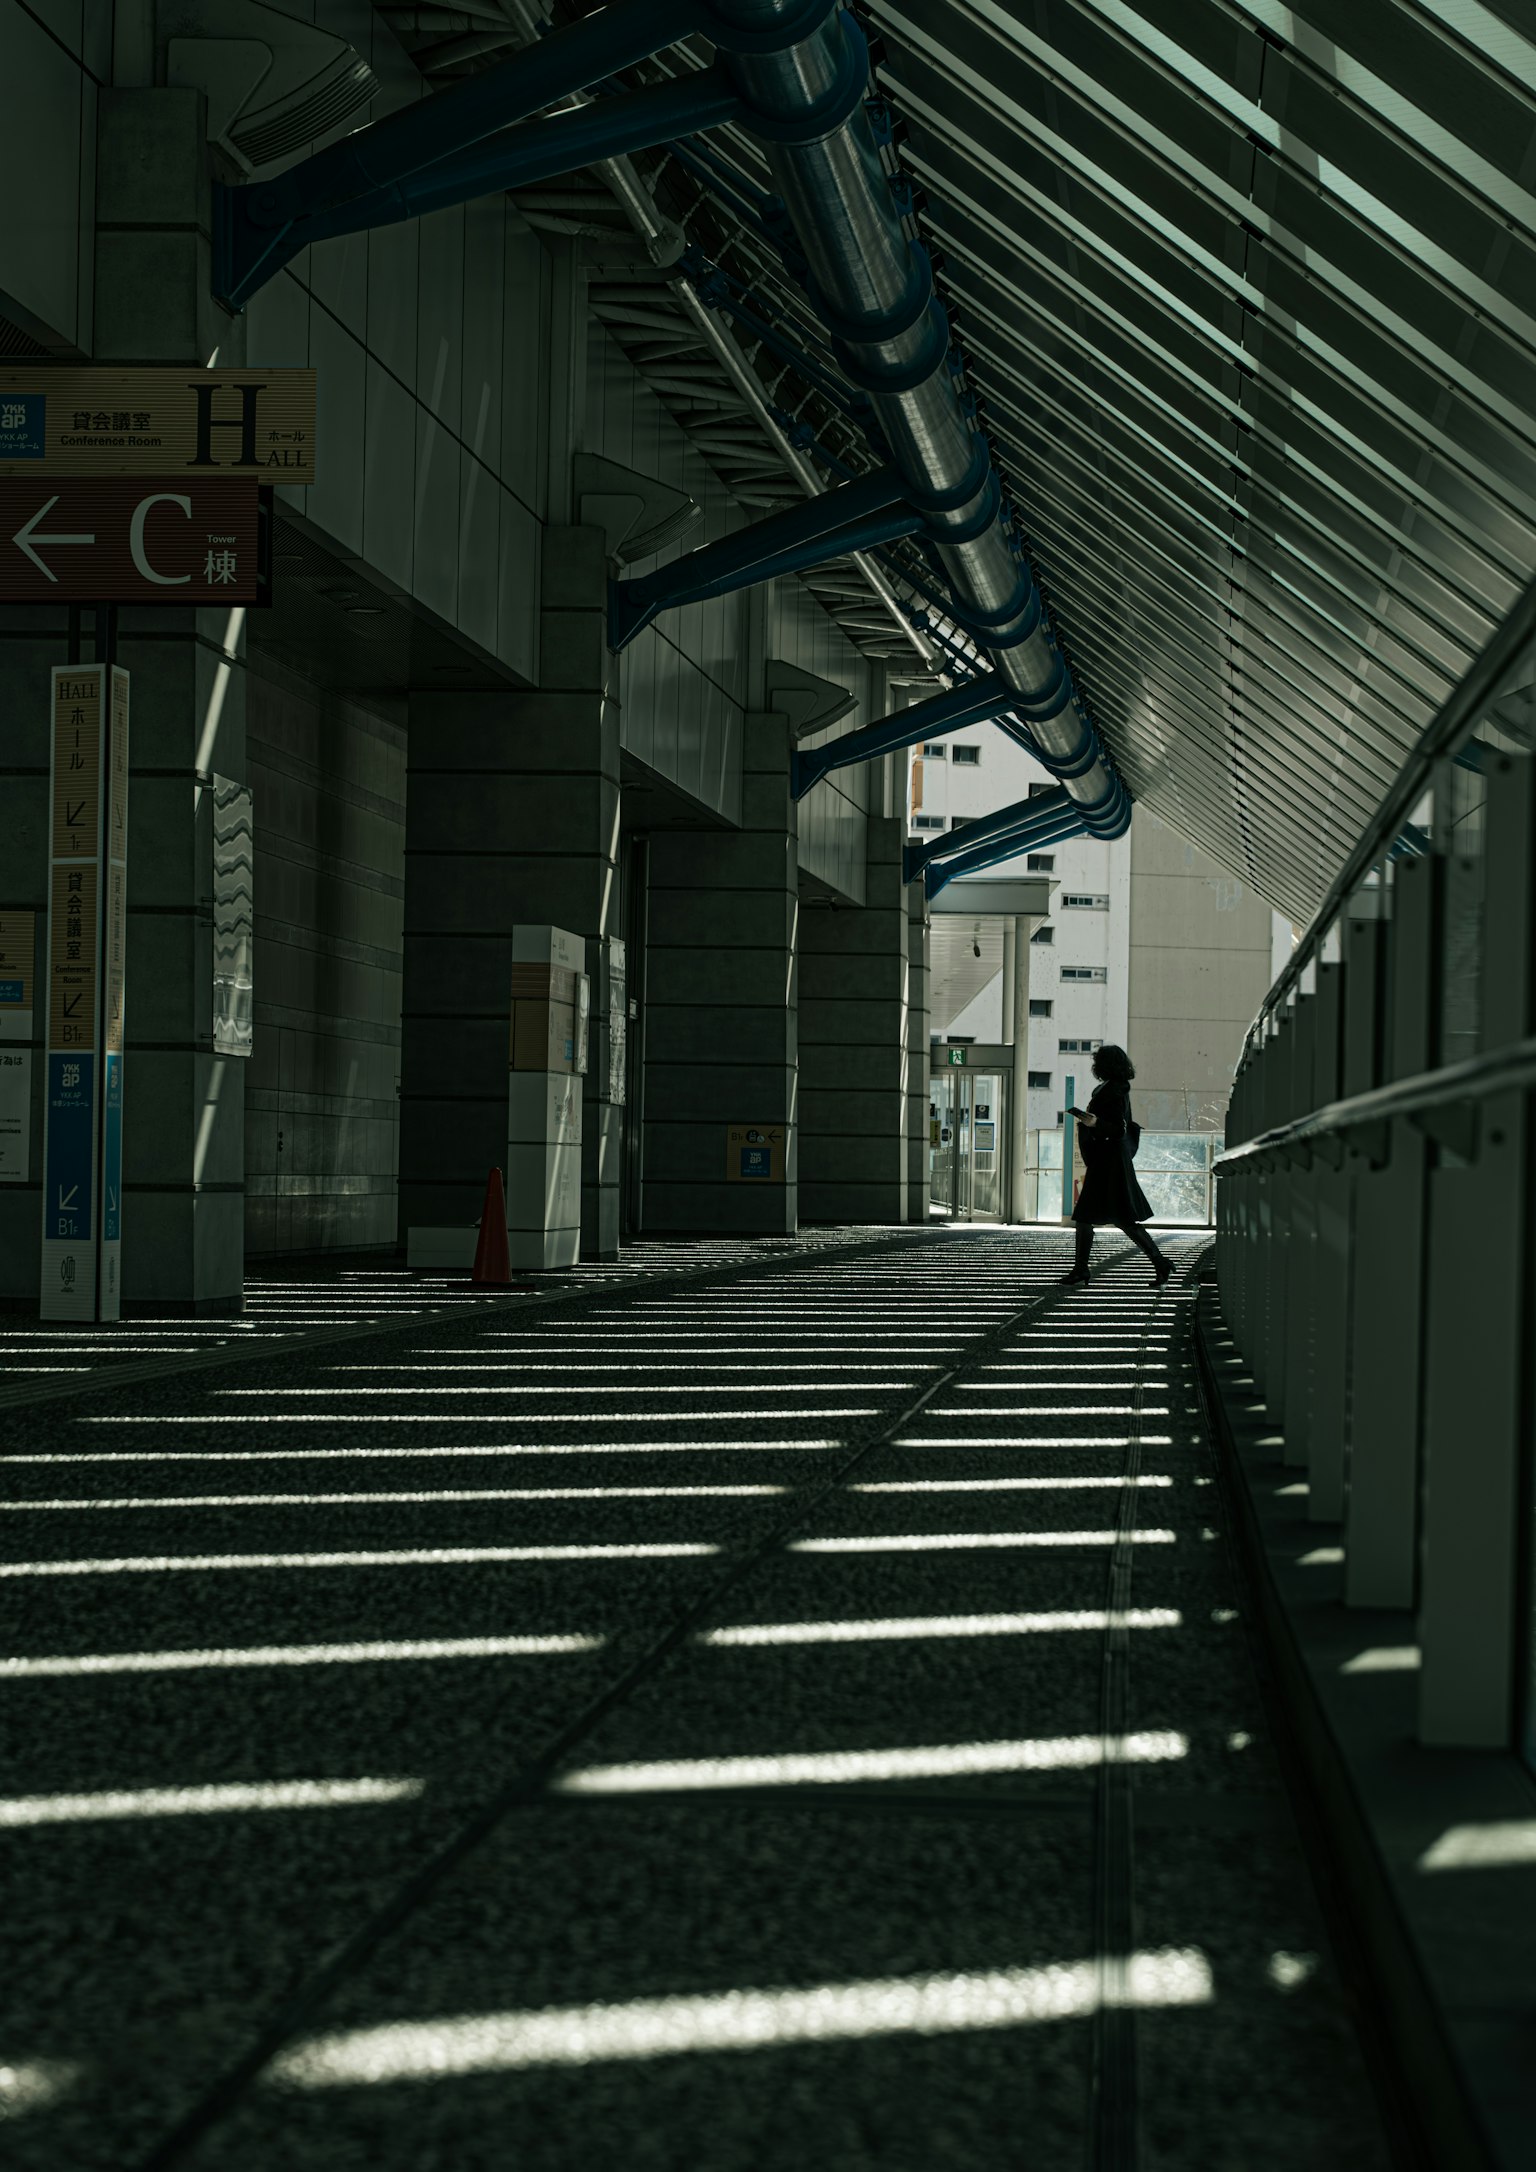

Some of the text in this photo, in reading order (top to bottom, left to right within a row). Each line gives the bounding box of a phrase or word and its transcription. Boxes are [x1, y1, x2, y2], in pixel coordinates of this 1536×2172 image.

[1, 404, 26, 414] YKK
[1, 413, 26, 429] ap
[72, 411, 151, 431] 貸会議室
[16, 433, 28, 441] AP
[61, 435, 162, 446] Conference Room
[268, 430, 305, 442] ホール
[130, 493, 192, 585] C
[207, 534, 237, 544] Tower
[203, 550, 238, 585] 棟
[59, 682, 97, 700] HALL
[69, 706, 85, 770] ホール
[66, 872, 83, 960] 貸会議室
[55, 965, 91, 973] Conference
[63, 976, 82, 984] Room
[63, 1025, 83, 1042] B1F
[62, 1063, 81, 1073] YKK
[62, 1073, 81, 1088] ap
[58, 1218, 79, 1235] B1F
